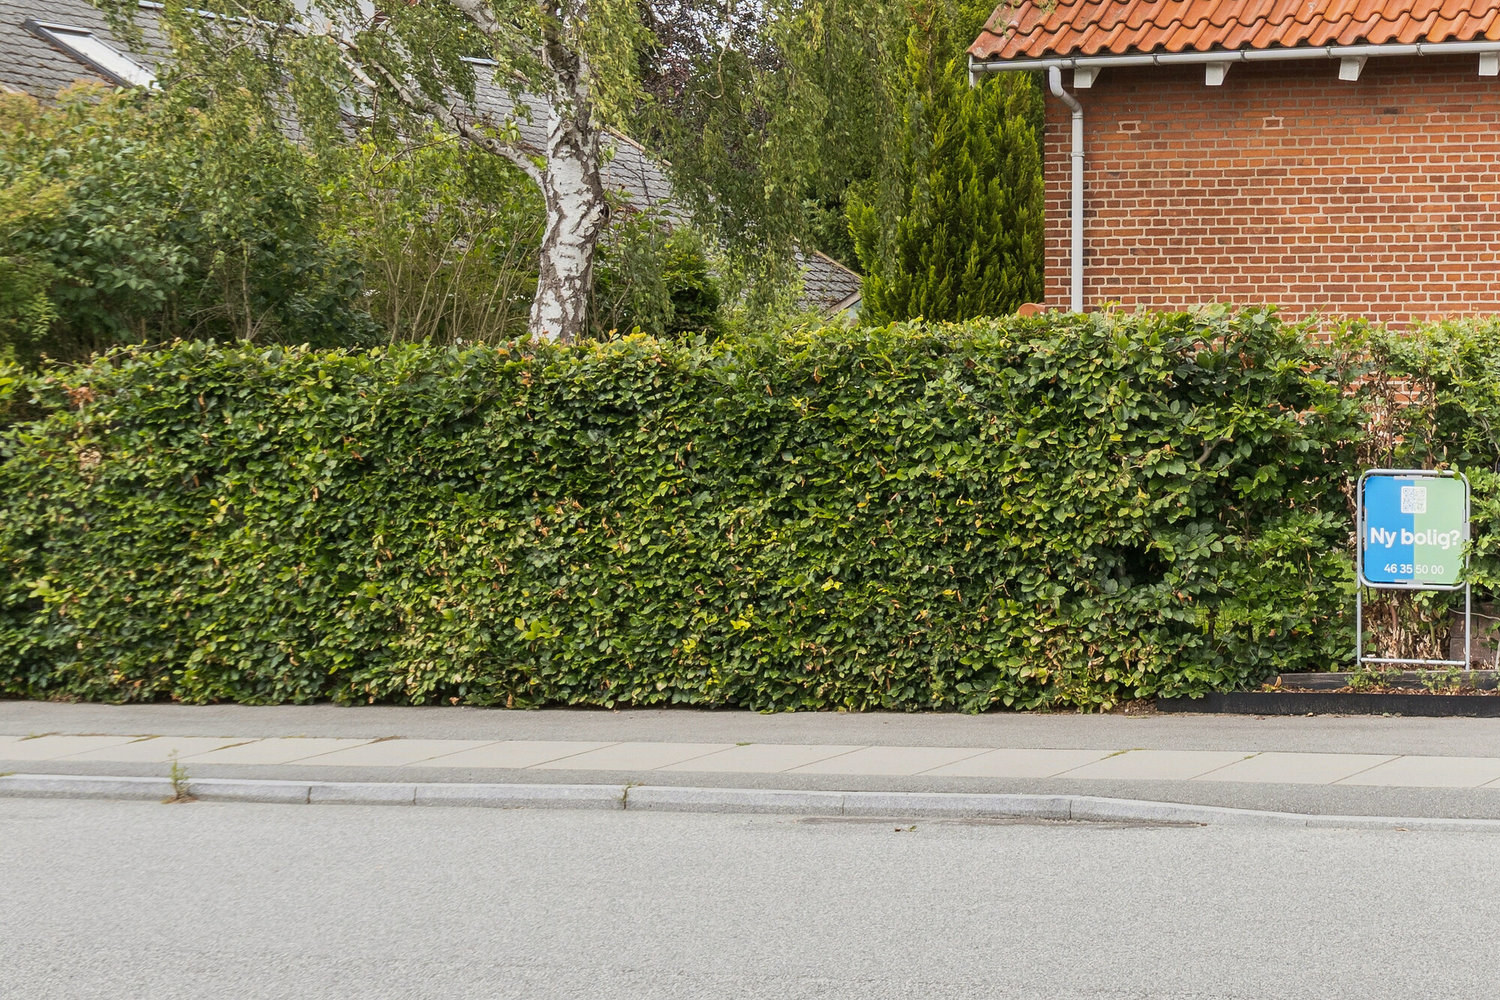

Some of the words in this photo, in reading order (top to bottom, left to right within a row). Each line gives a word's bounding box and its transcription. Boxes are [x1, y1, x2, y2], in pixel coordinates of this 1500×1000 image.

[1370, 527, 1397, 548] Ny
[1401, 528, 1461, 550] bolig?
[1384, 563, 1398, 574] 46
[1400, 563, 1413, 575] 35
[1415, 564, 1429, 575] 50
[1431, 564, 1444, 575] 00
